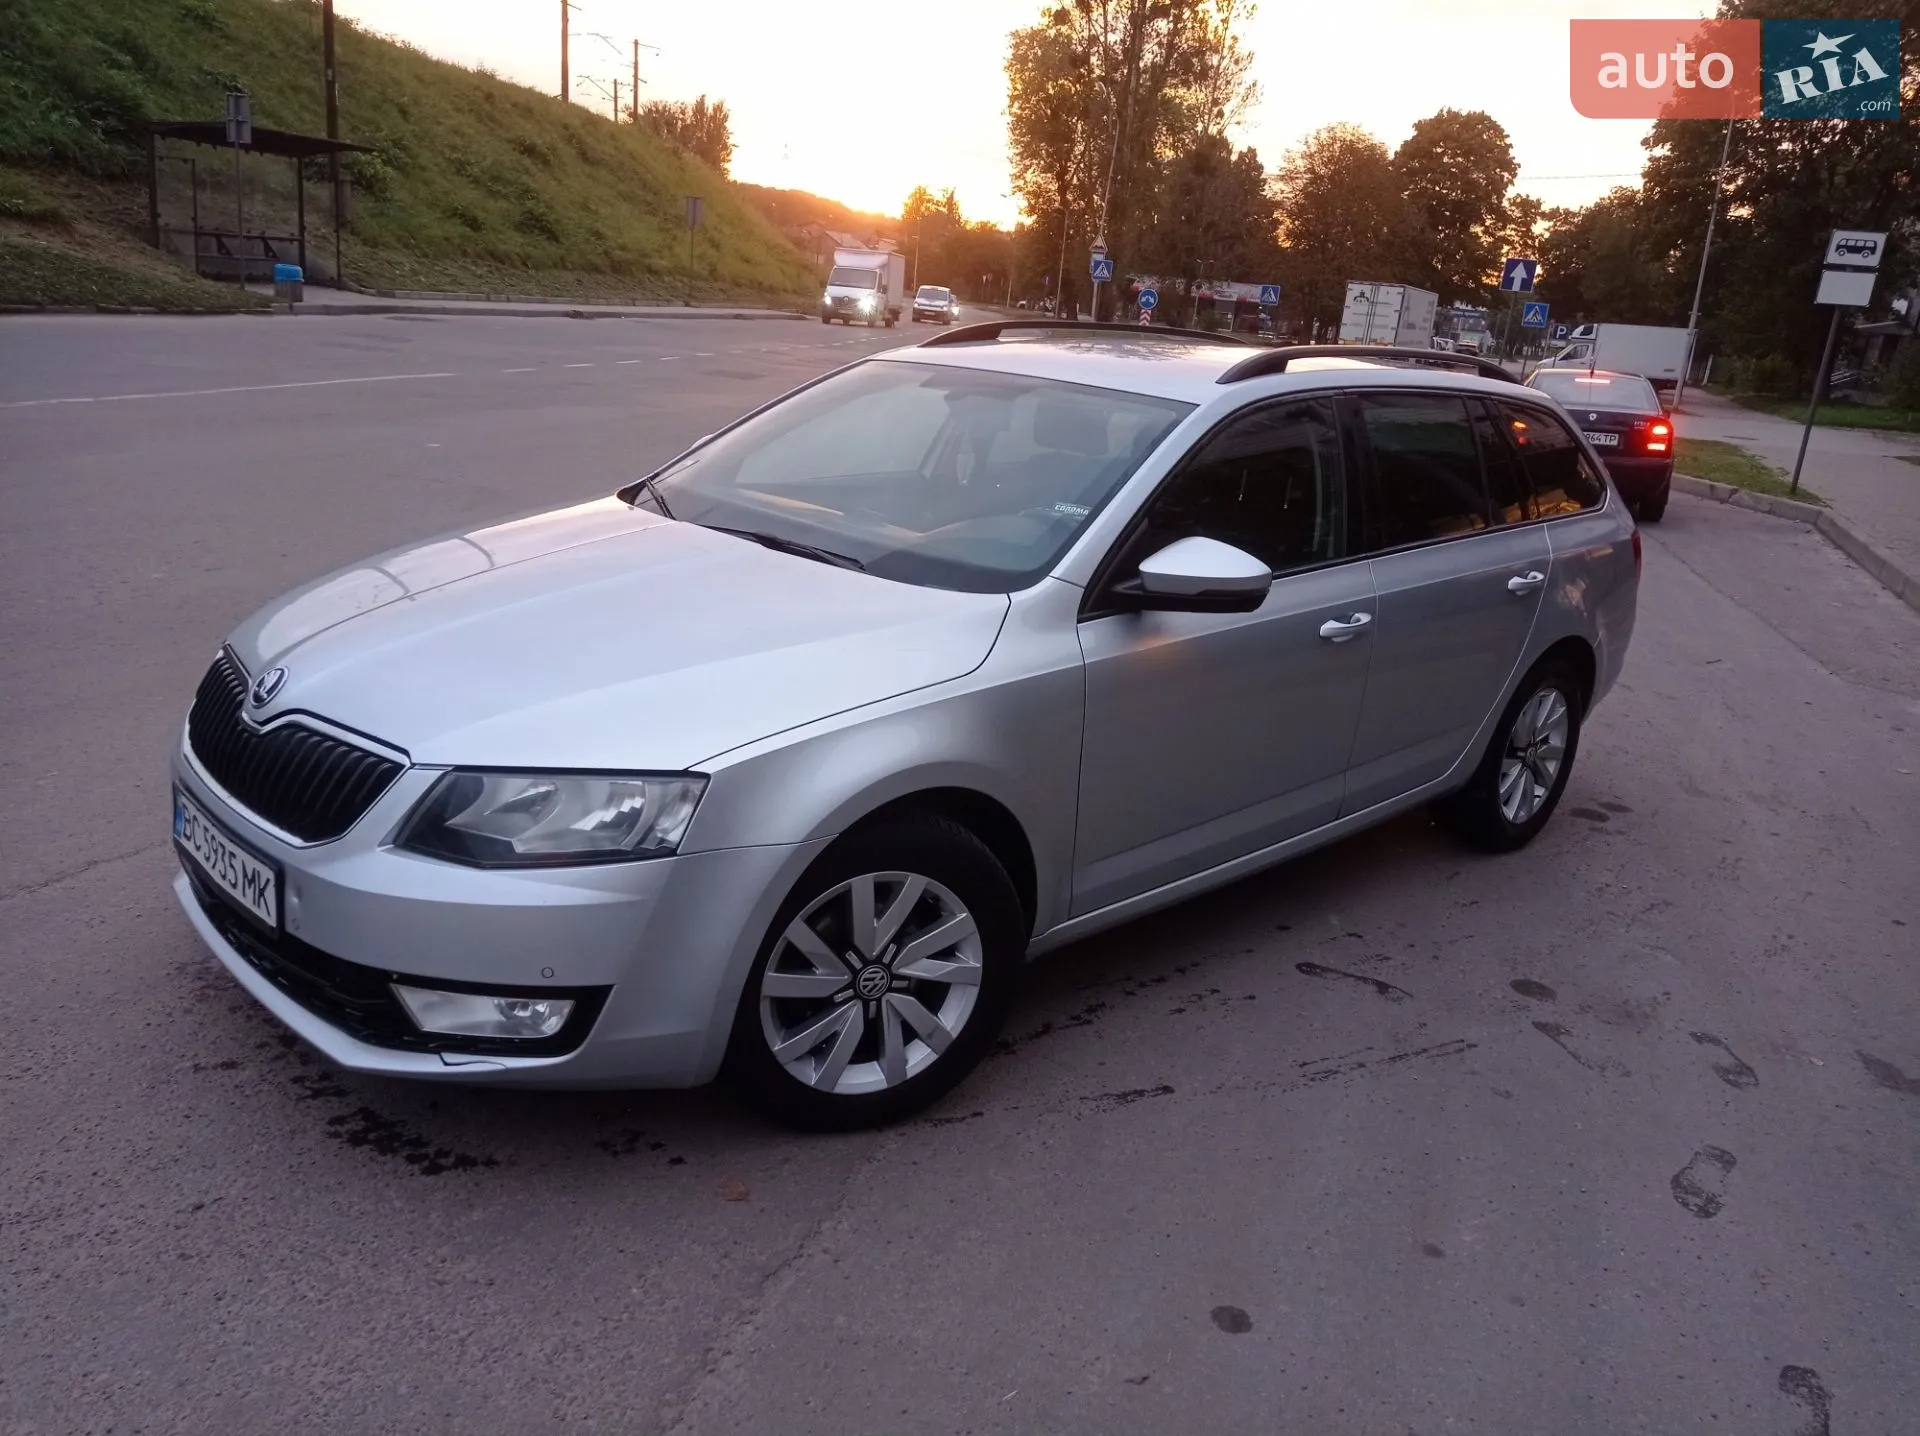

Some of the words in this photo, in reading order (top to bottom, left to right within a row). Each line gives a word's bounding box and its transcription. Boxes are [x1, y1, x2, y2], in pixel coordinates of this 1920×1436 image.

[1556, 326, 1567, 339] P
[1604, 433, 1617, 443] TP
[182, 803, 202, 852] BC
[203, 825, 239, 890] 5935
[241, 859, 272, 918] MK
